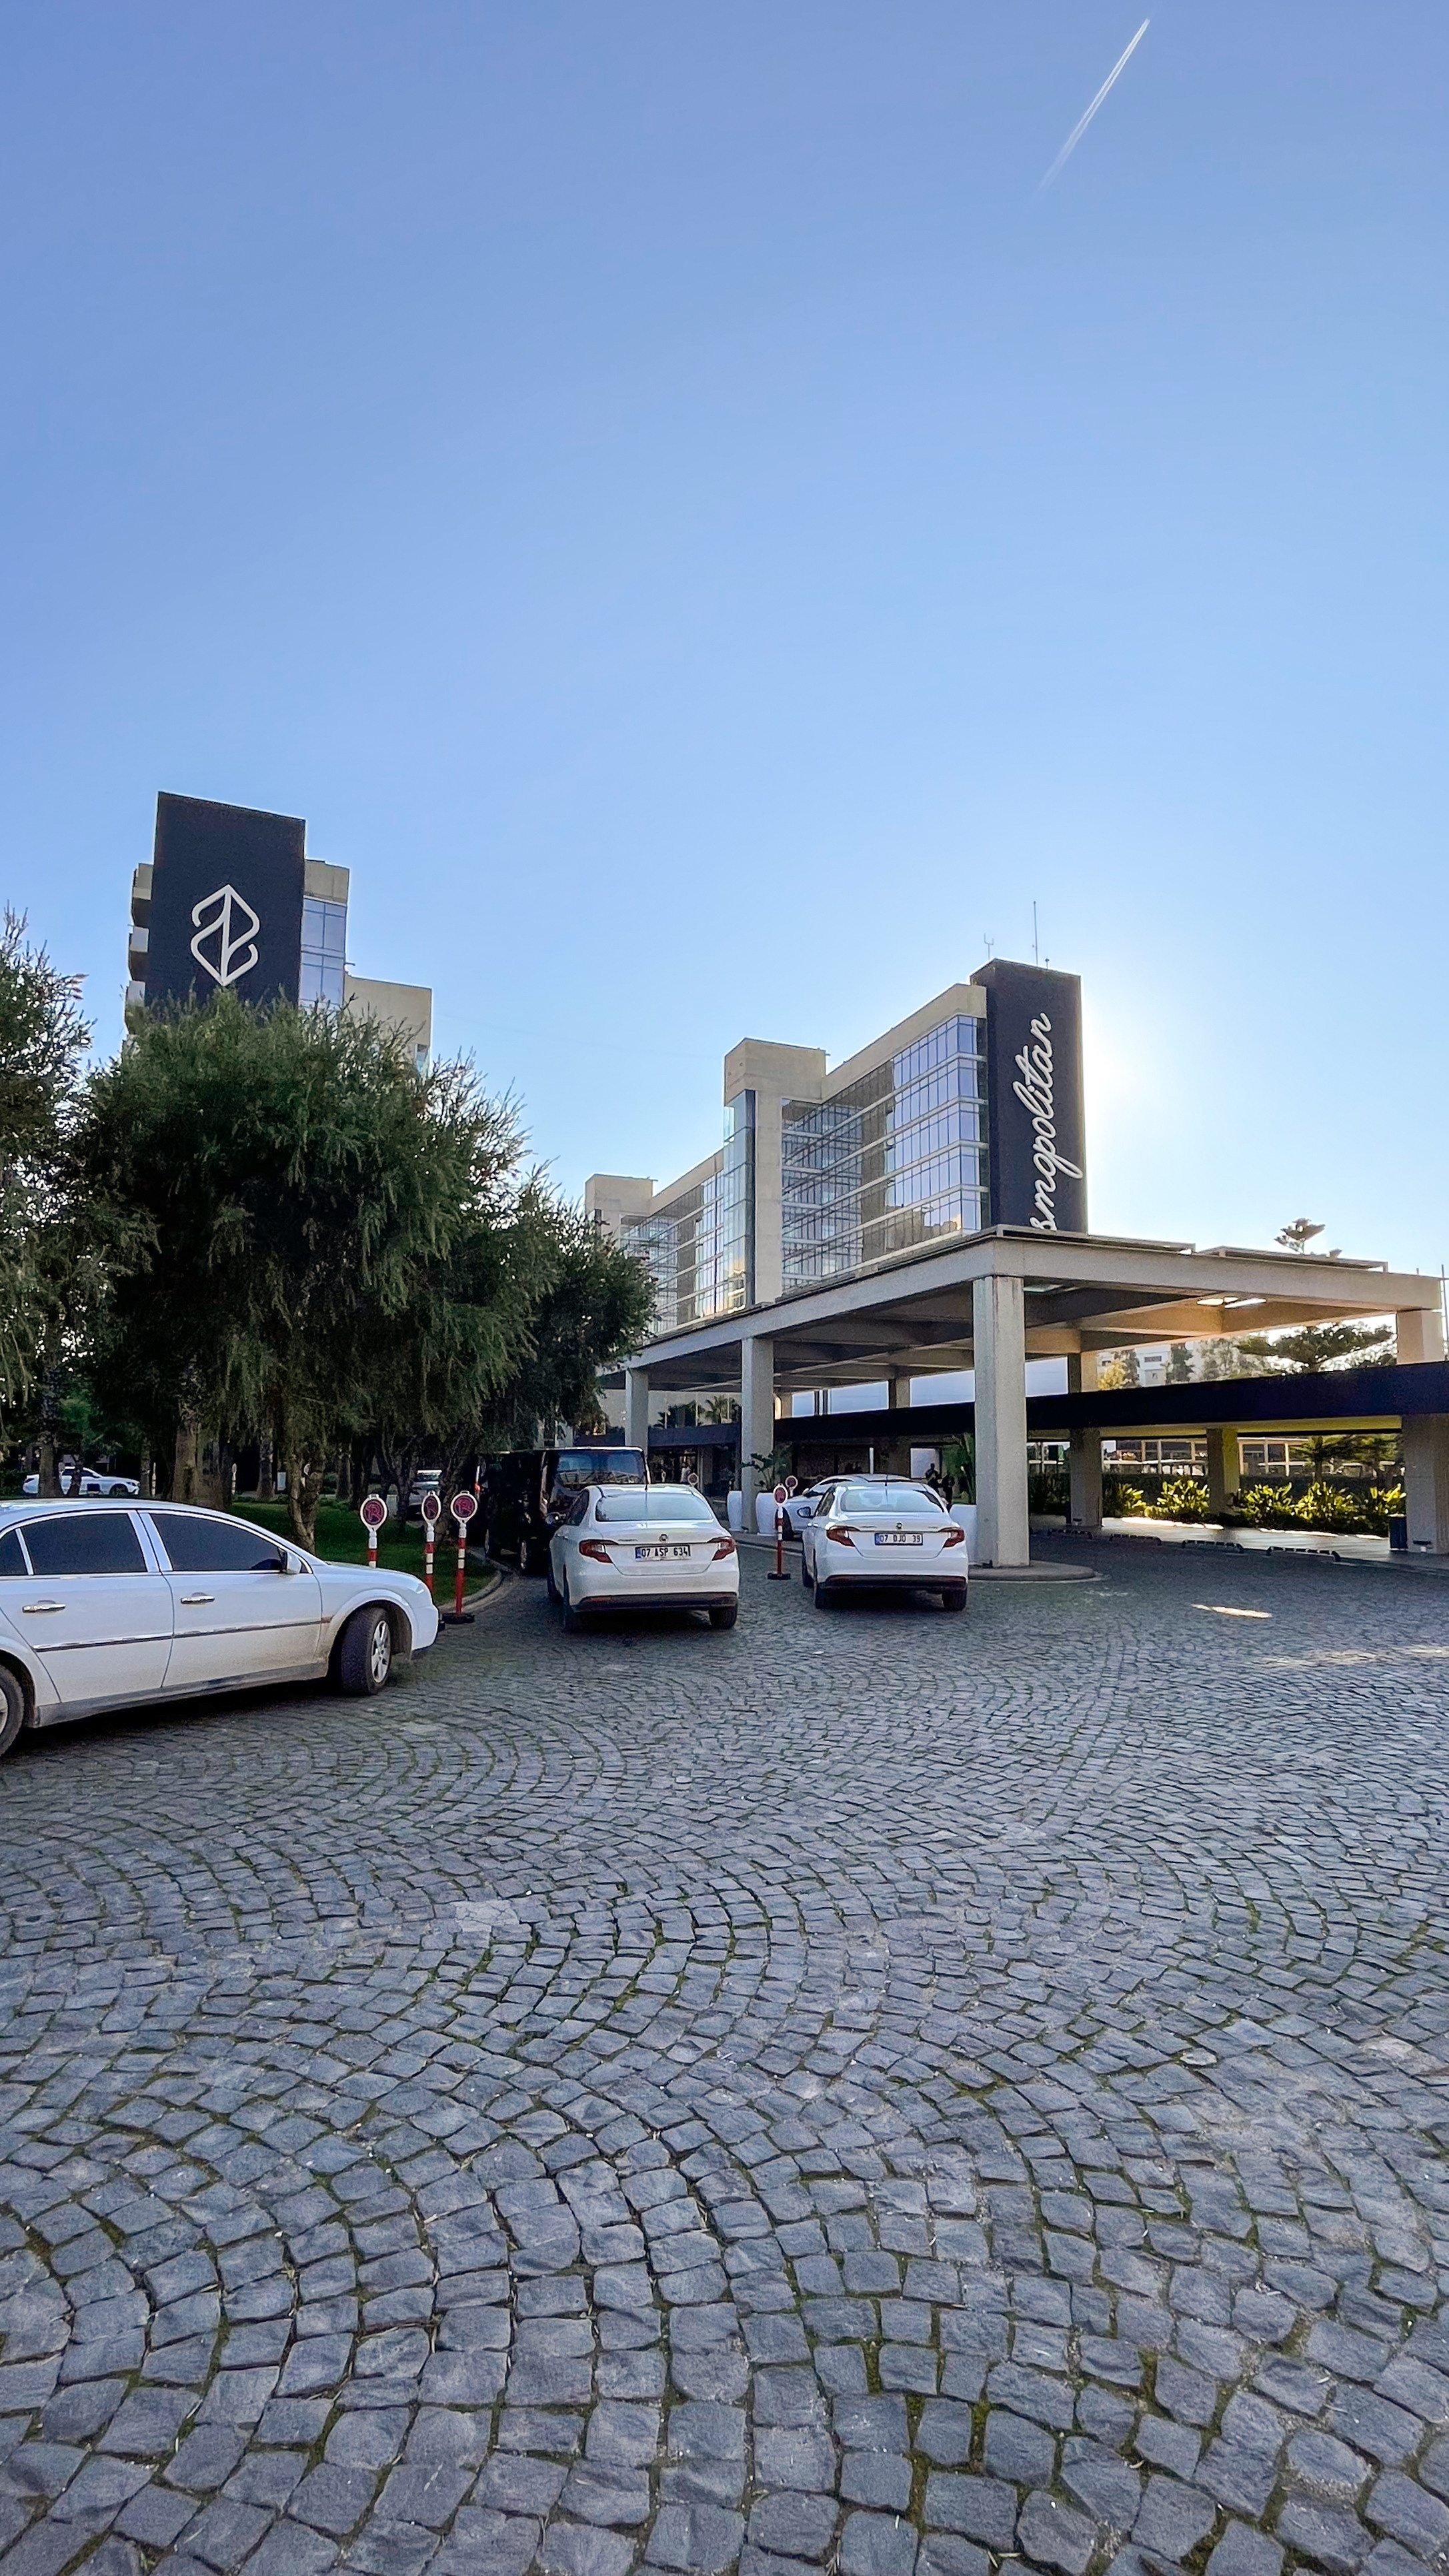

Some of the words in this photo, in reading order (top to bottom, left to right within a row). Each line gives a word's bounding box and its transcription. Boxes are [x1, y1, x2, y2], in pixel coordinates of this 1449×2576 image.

[641, 1548, 651, 1558] 07
[654, 1548, 669, 1556] ASP
[673, 1547, 688, 1556] 634
